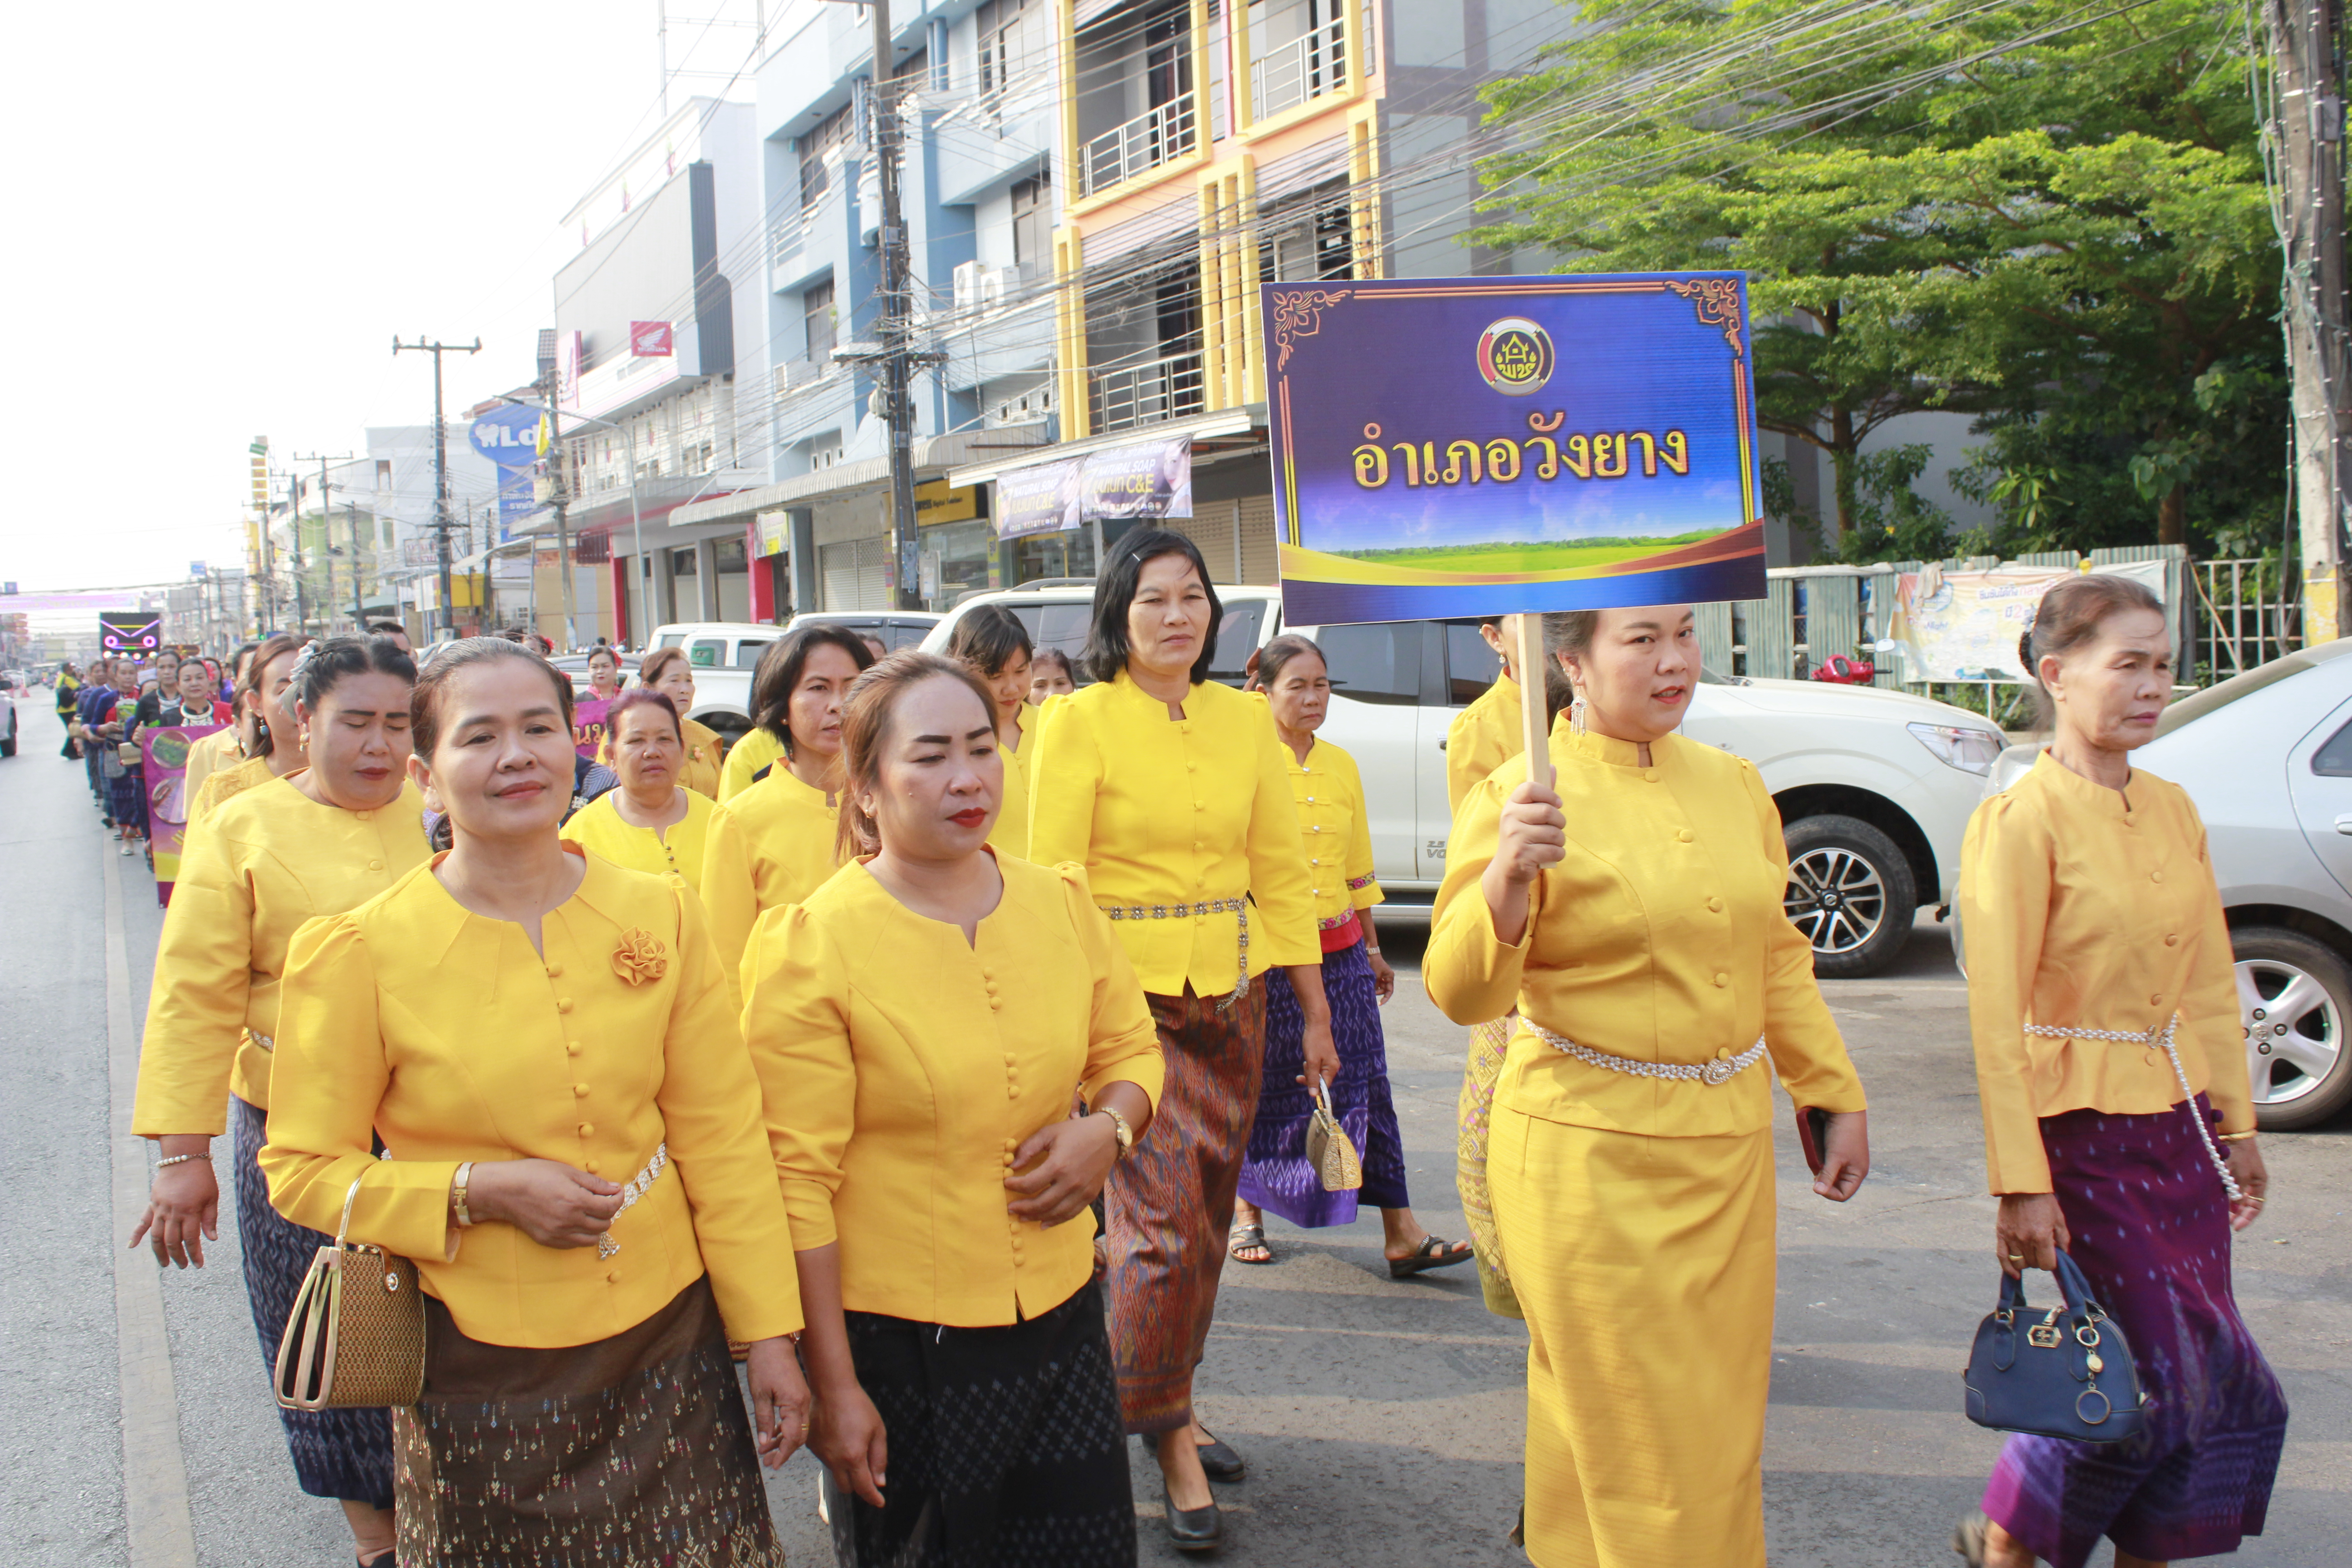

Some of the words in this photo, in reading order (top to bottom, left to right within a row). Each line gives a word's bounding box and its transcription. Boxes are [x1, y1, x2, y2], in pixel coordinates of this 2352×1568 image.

[500, 424, 539, 447] Ld
[1352, 411, 1688, 488] อำเภอวังยาง
[1097, 461, 1130, 477] NATURAL
[1131, 459, 1156, 473] SOAP
[1013, 482, 1040, 498] NATURAL
[1041, 478, 1059, 492] SOAP
[1126, 473, 1155, 494] C&E
[1036, 490, 1056, 511] C&E
[2014, 604, 2023, 618] 2
